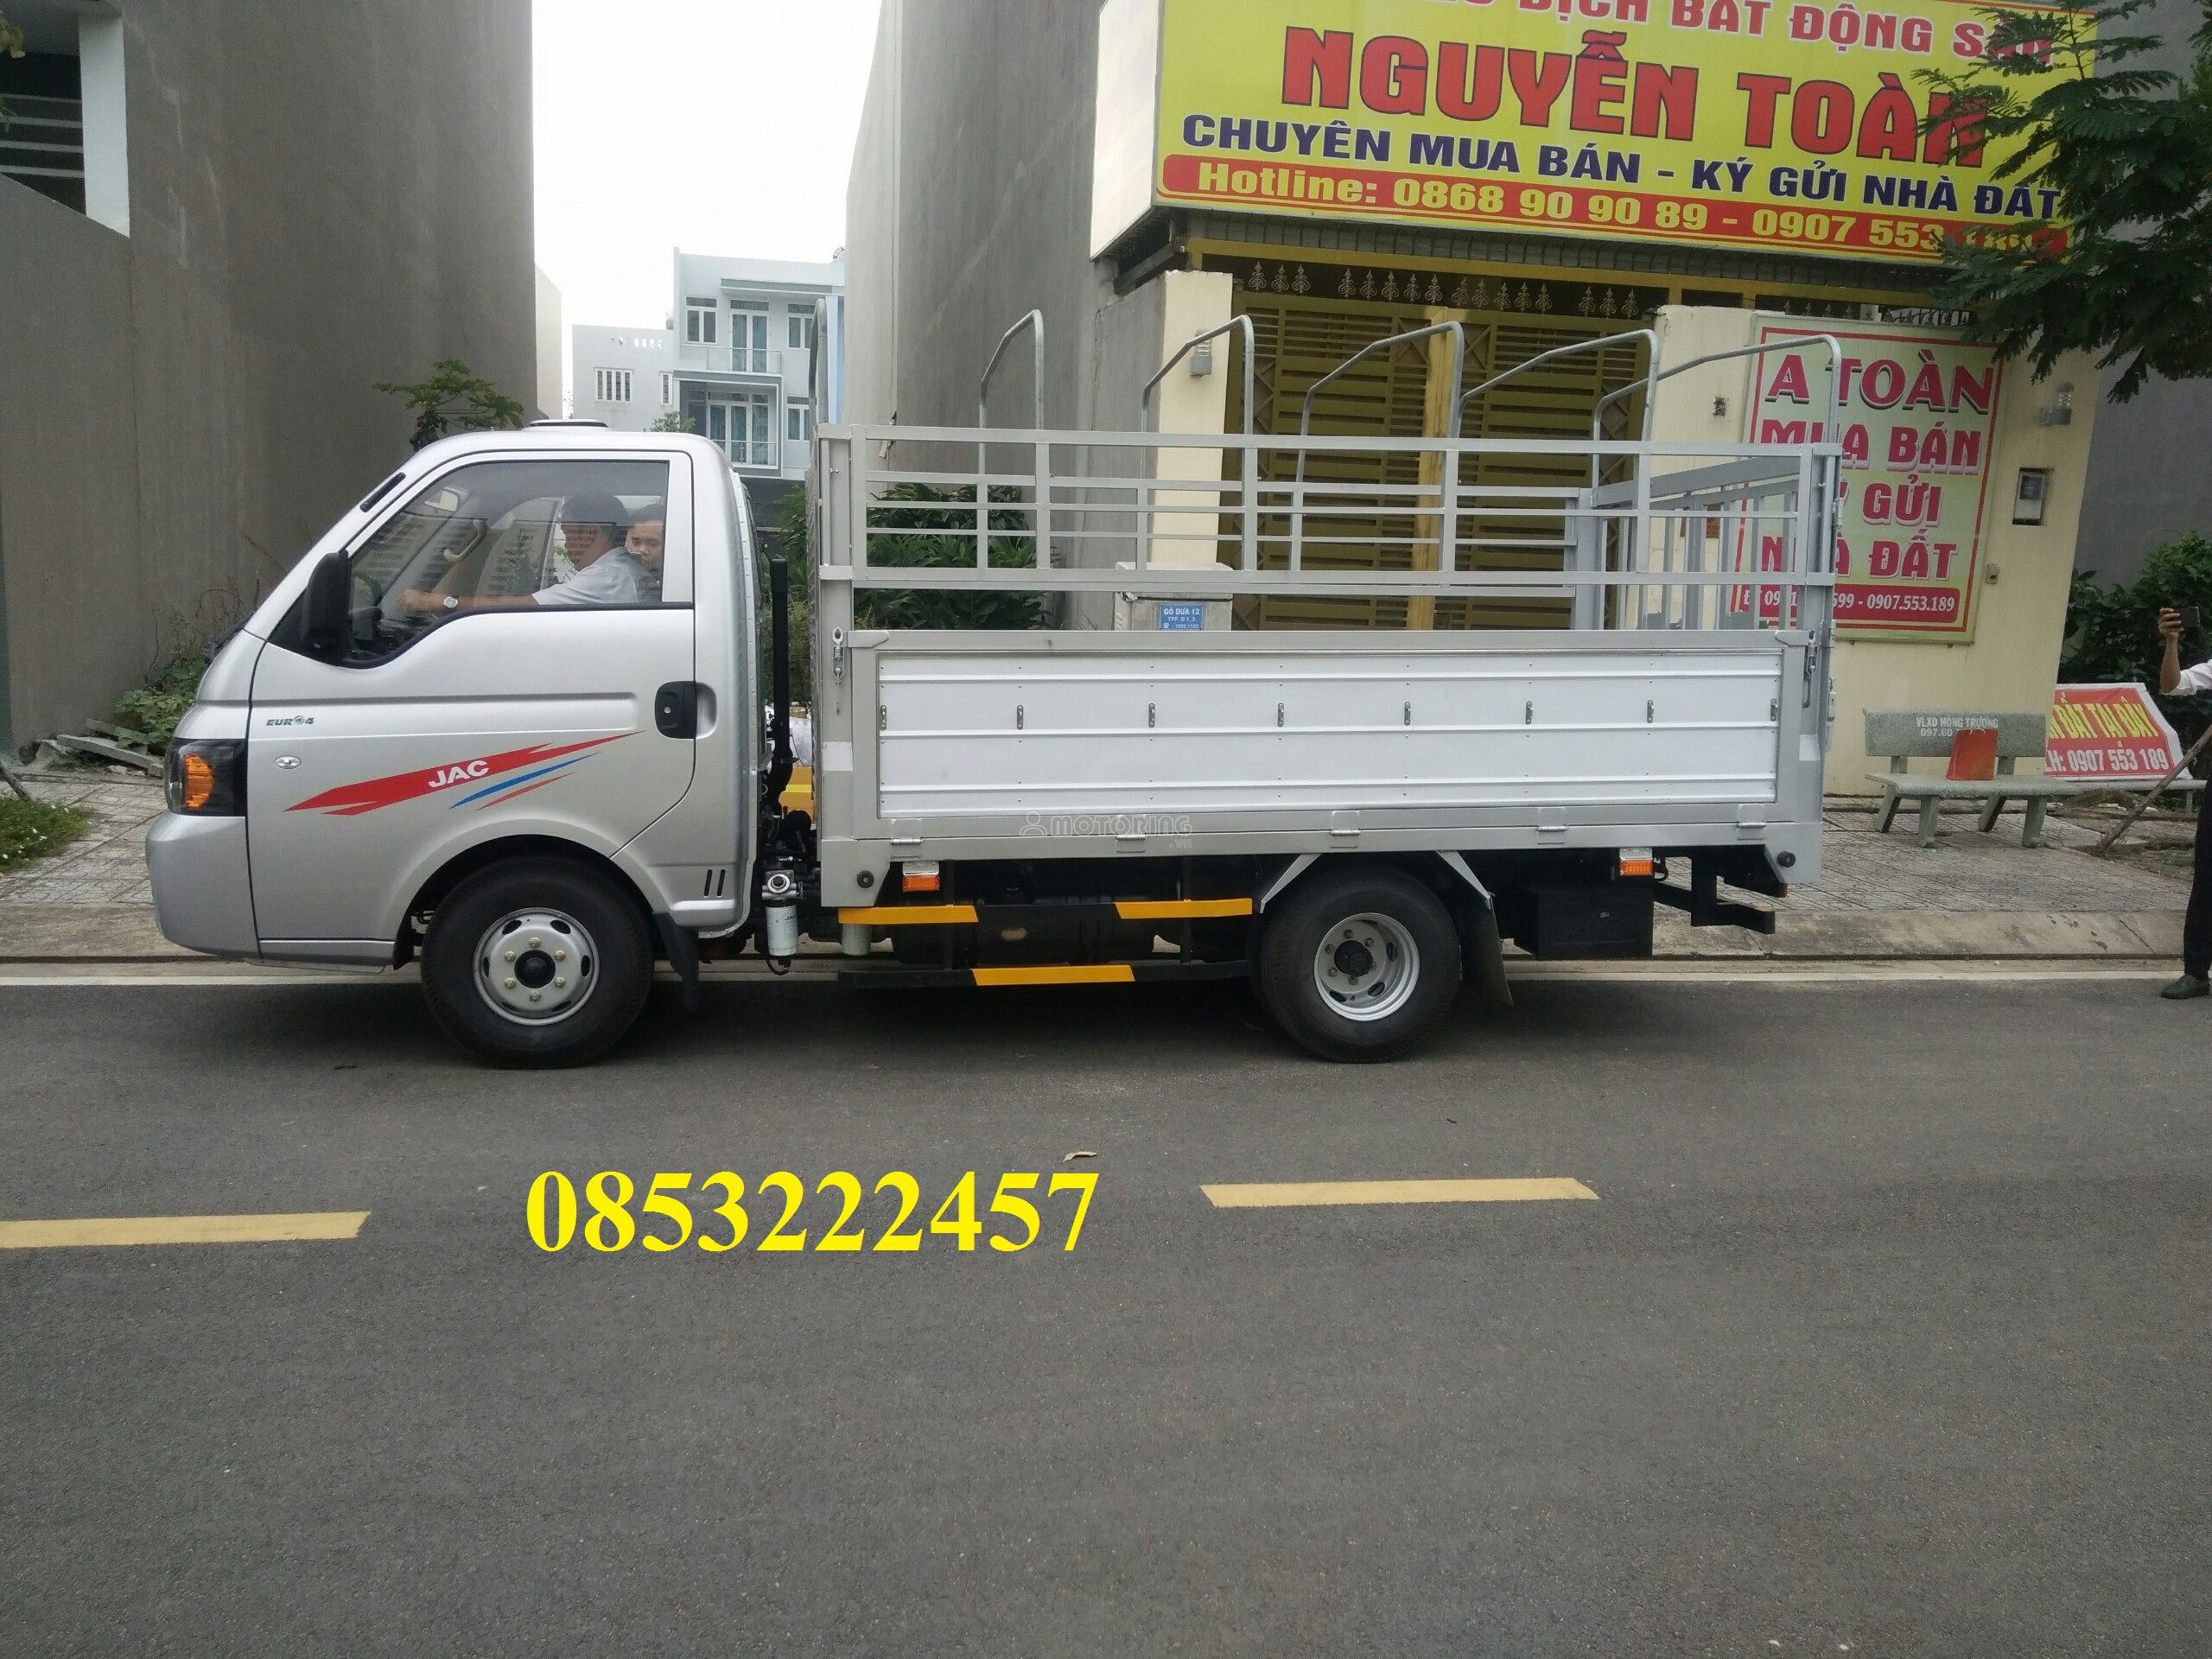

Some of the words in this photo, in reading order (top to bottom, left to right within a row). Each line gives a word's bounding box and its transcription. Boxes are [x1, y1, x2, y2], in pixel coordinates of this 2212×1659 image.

[1789, 3, 1933, 53] ĐỘNG
[1281, 26, 1700, 143] NGUYỄN
[1736, 71, 1988, 168] TOÀN
[1182, 113, 1391, 162] CHUYÊN
[1408, 132, 1521, 173] MUA
[1537, 142, 1641, 184] BÁN
[1691, 156, 1754, 194] KÝ
[1768, 159, 1847, 203] GỬI
[1863, 174, 1959, 213] NHÀ
[1198, 162, 1378, 205] Hotline:
[1392, 175, 1504, 213] 0868
[1519, 188, 1573, 219] 90
[1587, 194, 1641, 226] 90
[1655, 200, 1708, 230] 89
[1752, 208, 1857, 243] 0907
[1869, 219, 1945, 250] 553
[1887, 421, 1983, 474] BÁN
[1861, 474, 1943, 527] GỬI
[1868, 528, 1959, 581] ĐẤT
[1866, 593, 1955, 613] 0907.553.189
[1916, 716, 1938, 728] VLXD
[429, 760, 490, 790] JAC
[2067, 749, 2105, 772] 0907
[2107, 748, 2139, 772] 553
[2139, 747, 2170, 771] 189
